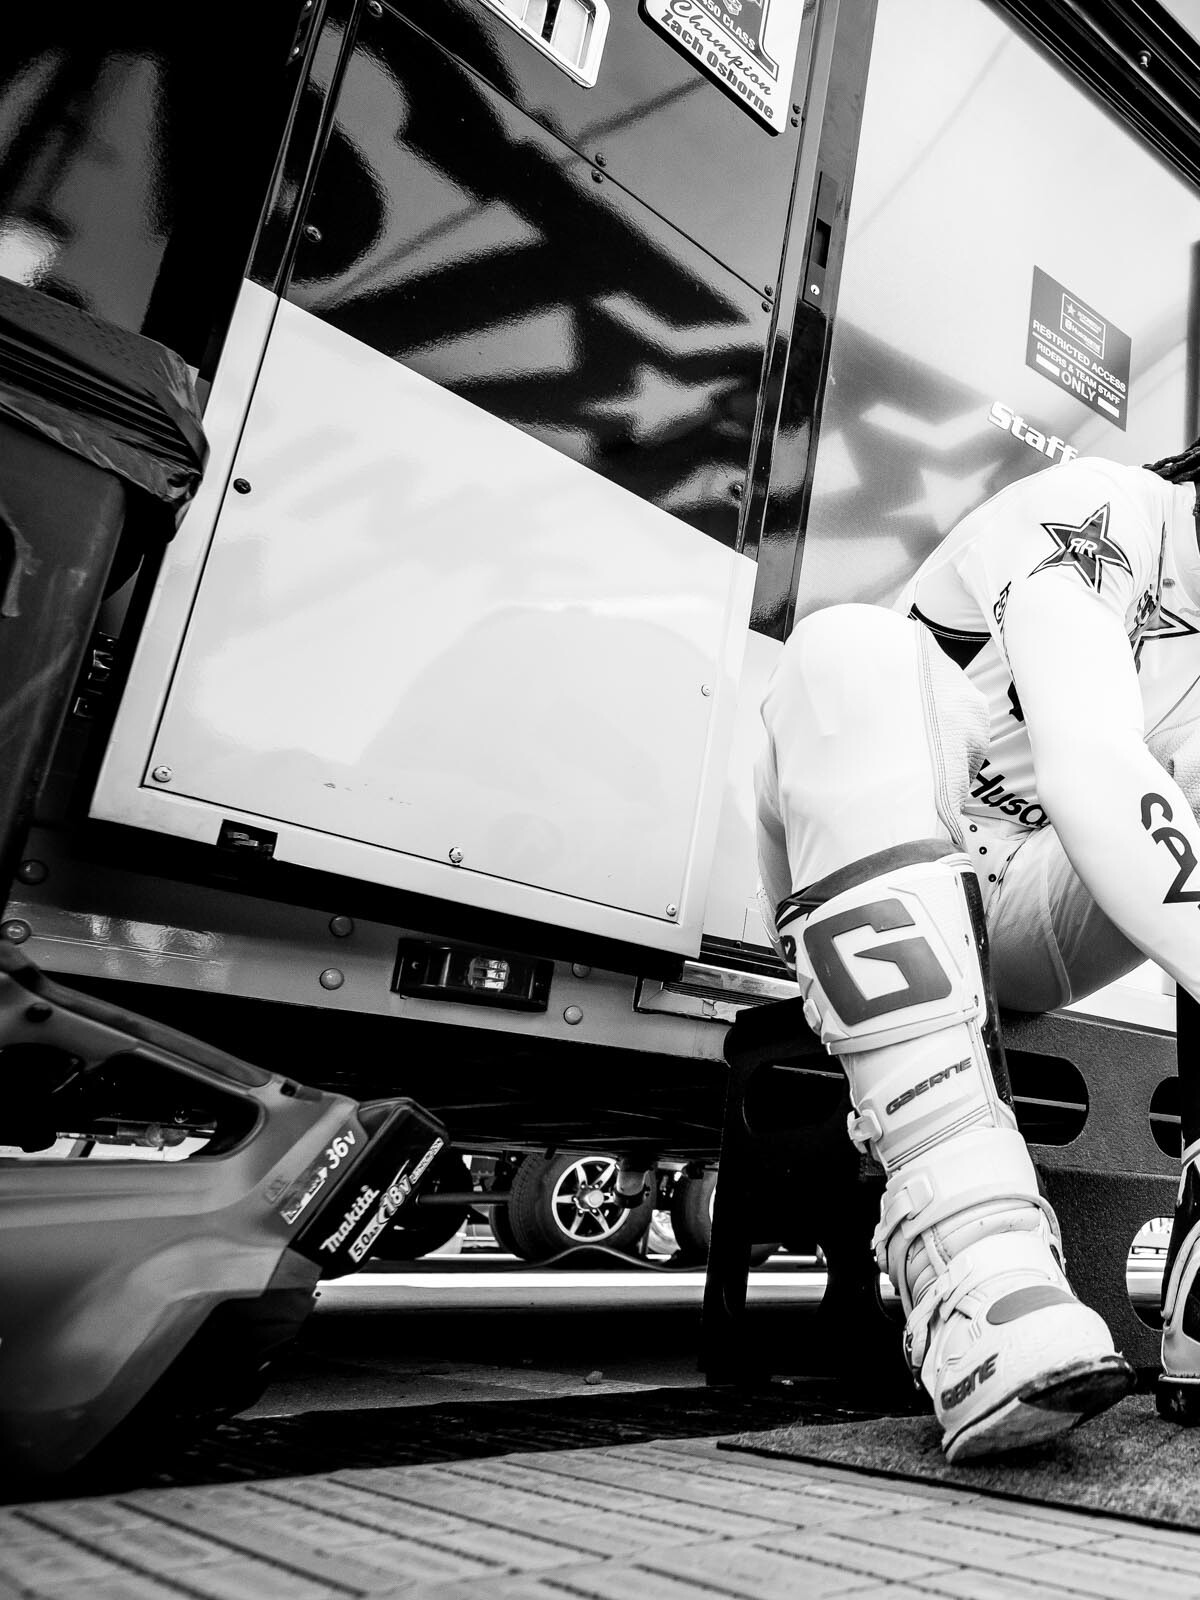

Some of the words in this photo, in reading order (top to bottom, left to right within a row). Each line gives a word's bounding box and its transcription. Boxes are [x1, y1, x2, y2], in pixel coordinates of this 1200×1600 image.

[660, 9, 704, 56] Zach
[706, 51, 774, 119] Osborne
[669, 0, 772, 95] Champion
[722, 14, 756, 50] CLASS
[1033, 319, 1090, 366] RESTRICTED
[1091, 363, 1126, 393] ACCESS
[1037, 342, 1067, 368] RIDERS
[1075, 368, 1097, 388] TEAM
[1098, 384, 1121, 405] STAFF
[1061, 371, 1096, 402] ONLY
[802, 898, 952, 1027] G
[319, 1188, 380, 1253] makita
